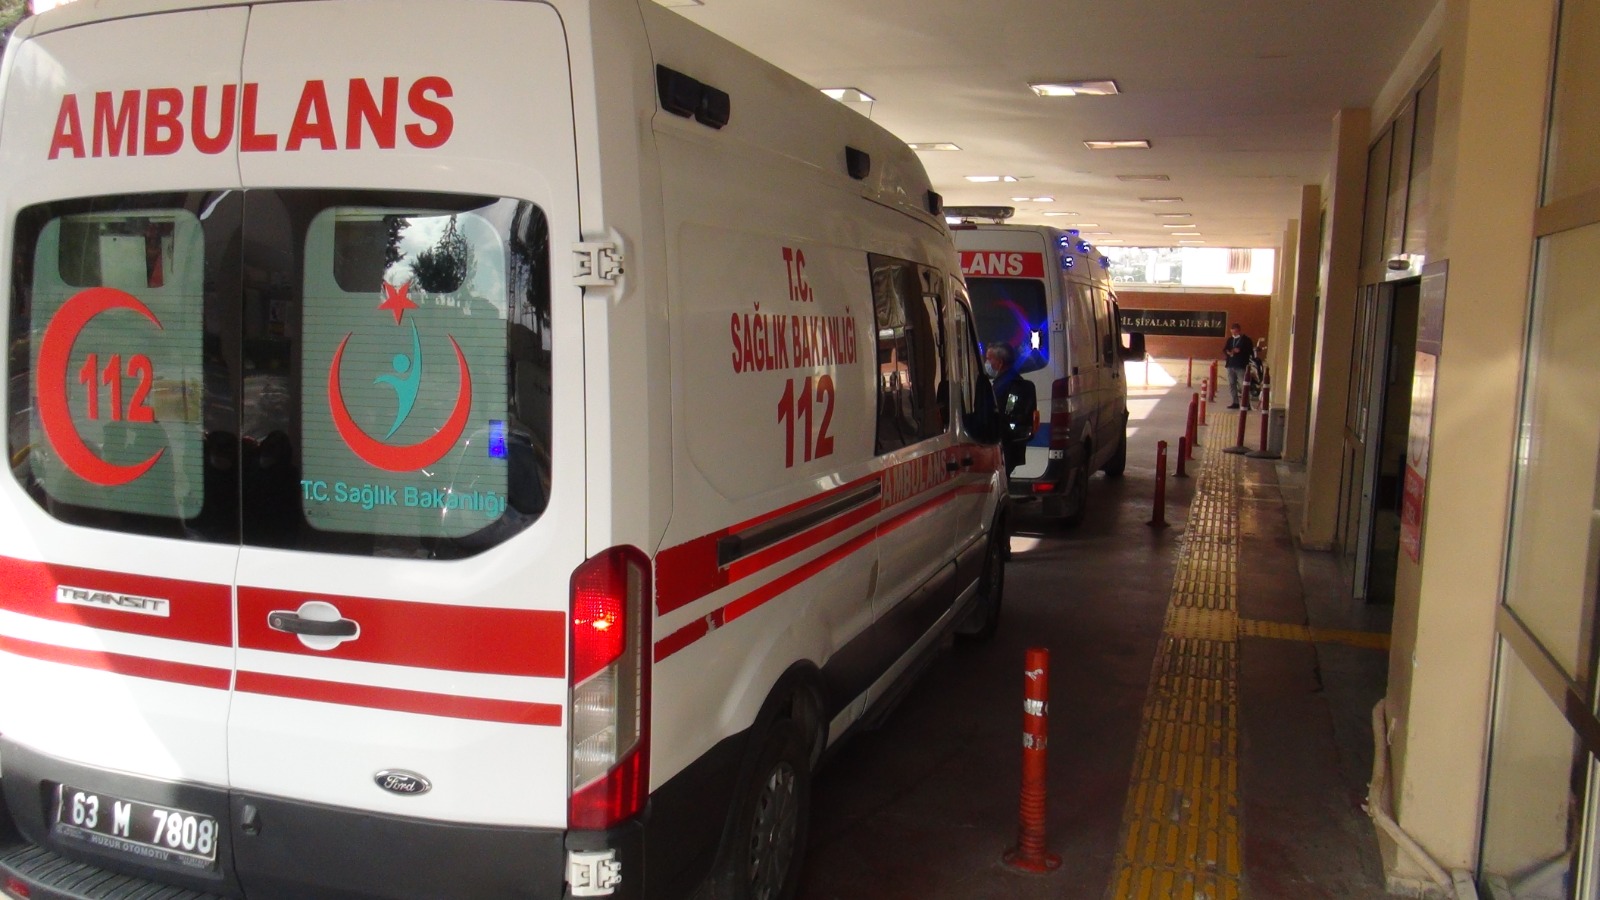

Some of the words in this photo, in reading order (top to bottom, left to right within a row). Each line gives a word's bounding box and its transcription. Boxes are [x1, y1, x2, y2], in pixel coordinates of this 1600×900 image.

[48, 75, 454, 160] AMBULANS
[782, 246, 813, 303] T.C.
[730, 301, 789, 374] SAĞLIK
[792, 305, 857, 369] BAKANLIĞI
[1119, 316, 1134, 326] İL
[79, 352, 155, 423] 112
[777, 374, 835, 469] 112
[301, 479, 330, 502] T.C.
[335, 484, 398, 511] Sağlık
[403, 485, 506, 518] Bakanlığı
[882, 449, 947, 506] AMBULANS
[58, 586, 167, 611] TRANSIT
[383, 774, 416, 792] Ford
[72, 791, 99, 829] 63
[113, 801, 132, 837] M
[152, 809, 214, 855] 7808
